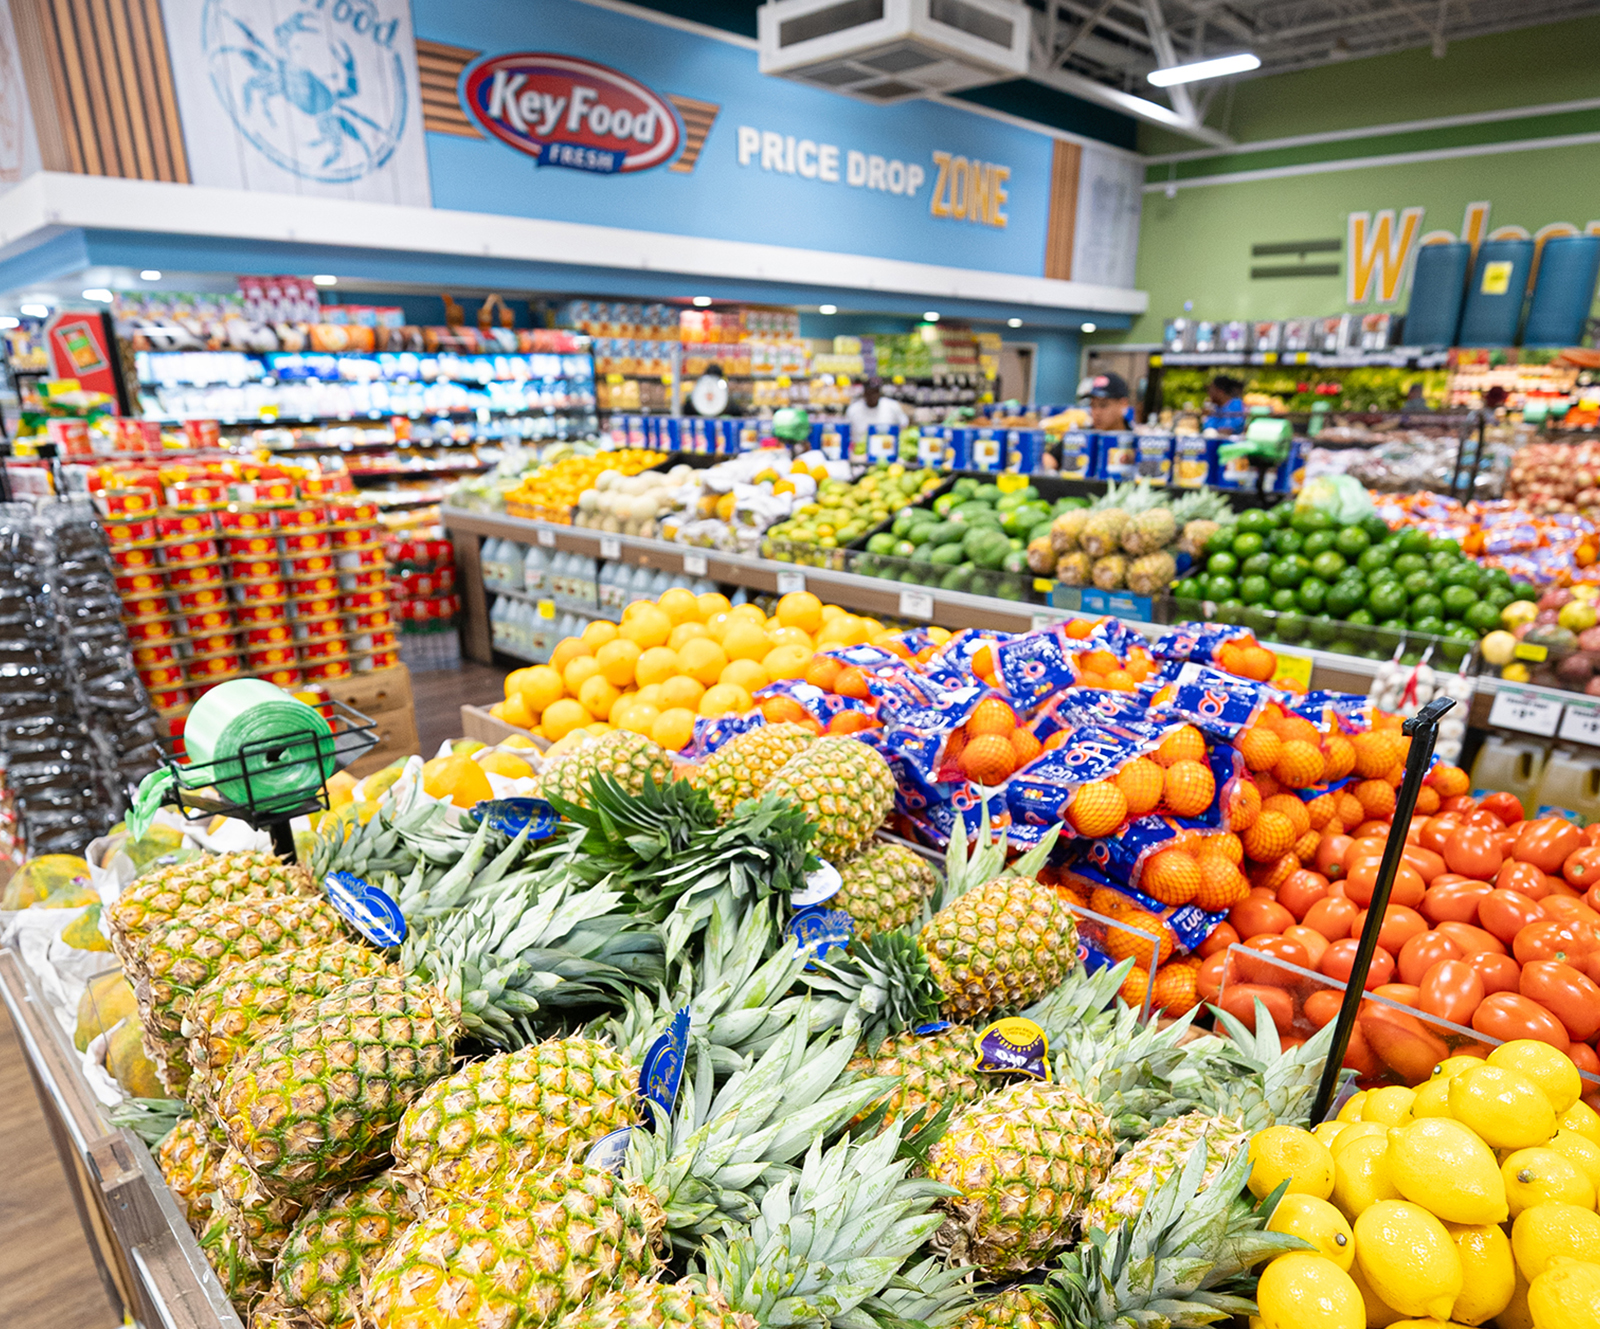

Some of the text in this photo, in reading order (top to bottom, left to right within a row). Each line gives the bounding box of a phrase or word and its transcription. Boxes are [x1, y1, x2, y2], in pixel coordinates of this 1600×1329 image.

[315, 0, 399, 49] ood
[489, 69, 657, 144] Key Food
[549, 143, 615, 171] FRESH
[737, 125, 1010, 228] PRICE DROP ZONE
[1182, 908, 1206, 932] LUC
